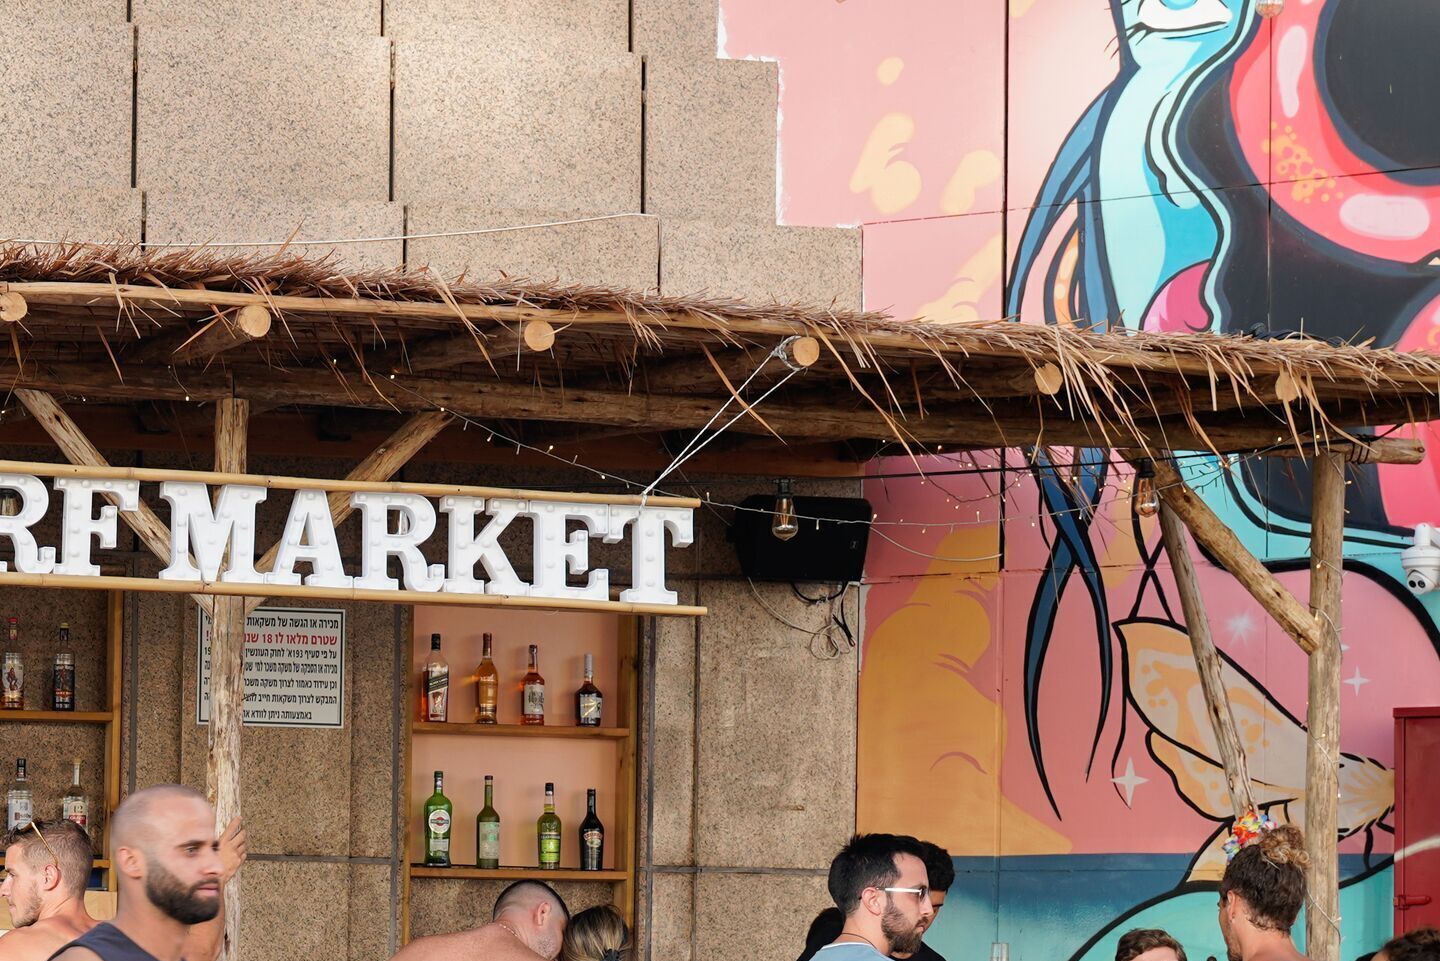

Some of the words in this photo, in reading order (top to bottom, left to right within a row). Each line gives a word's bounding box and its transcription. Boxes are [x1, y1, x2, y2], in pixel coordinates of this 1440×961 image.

[160, 482, 695, 605] MARKET
[246, 616, 276, 628] משקאות
[277, 616, 288, 627] של
[289, 618, 308, 628] הגשה
[309, 619, 317, 629] או
[318, 619, 339, 629] מכירה
[262, 633, 273, 644] 18
[274, 632, 284, 644] לו
[286, 632, 309, 645] מלאו
[311, 634, 338, 645] שטרם
[328, 649, 337, 659] על
